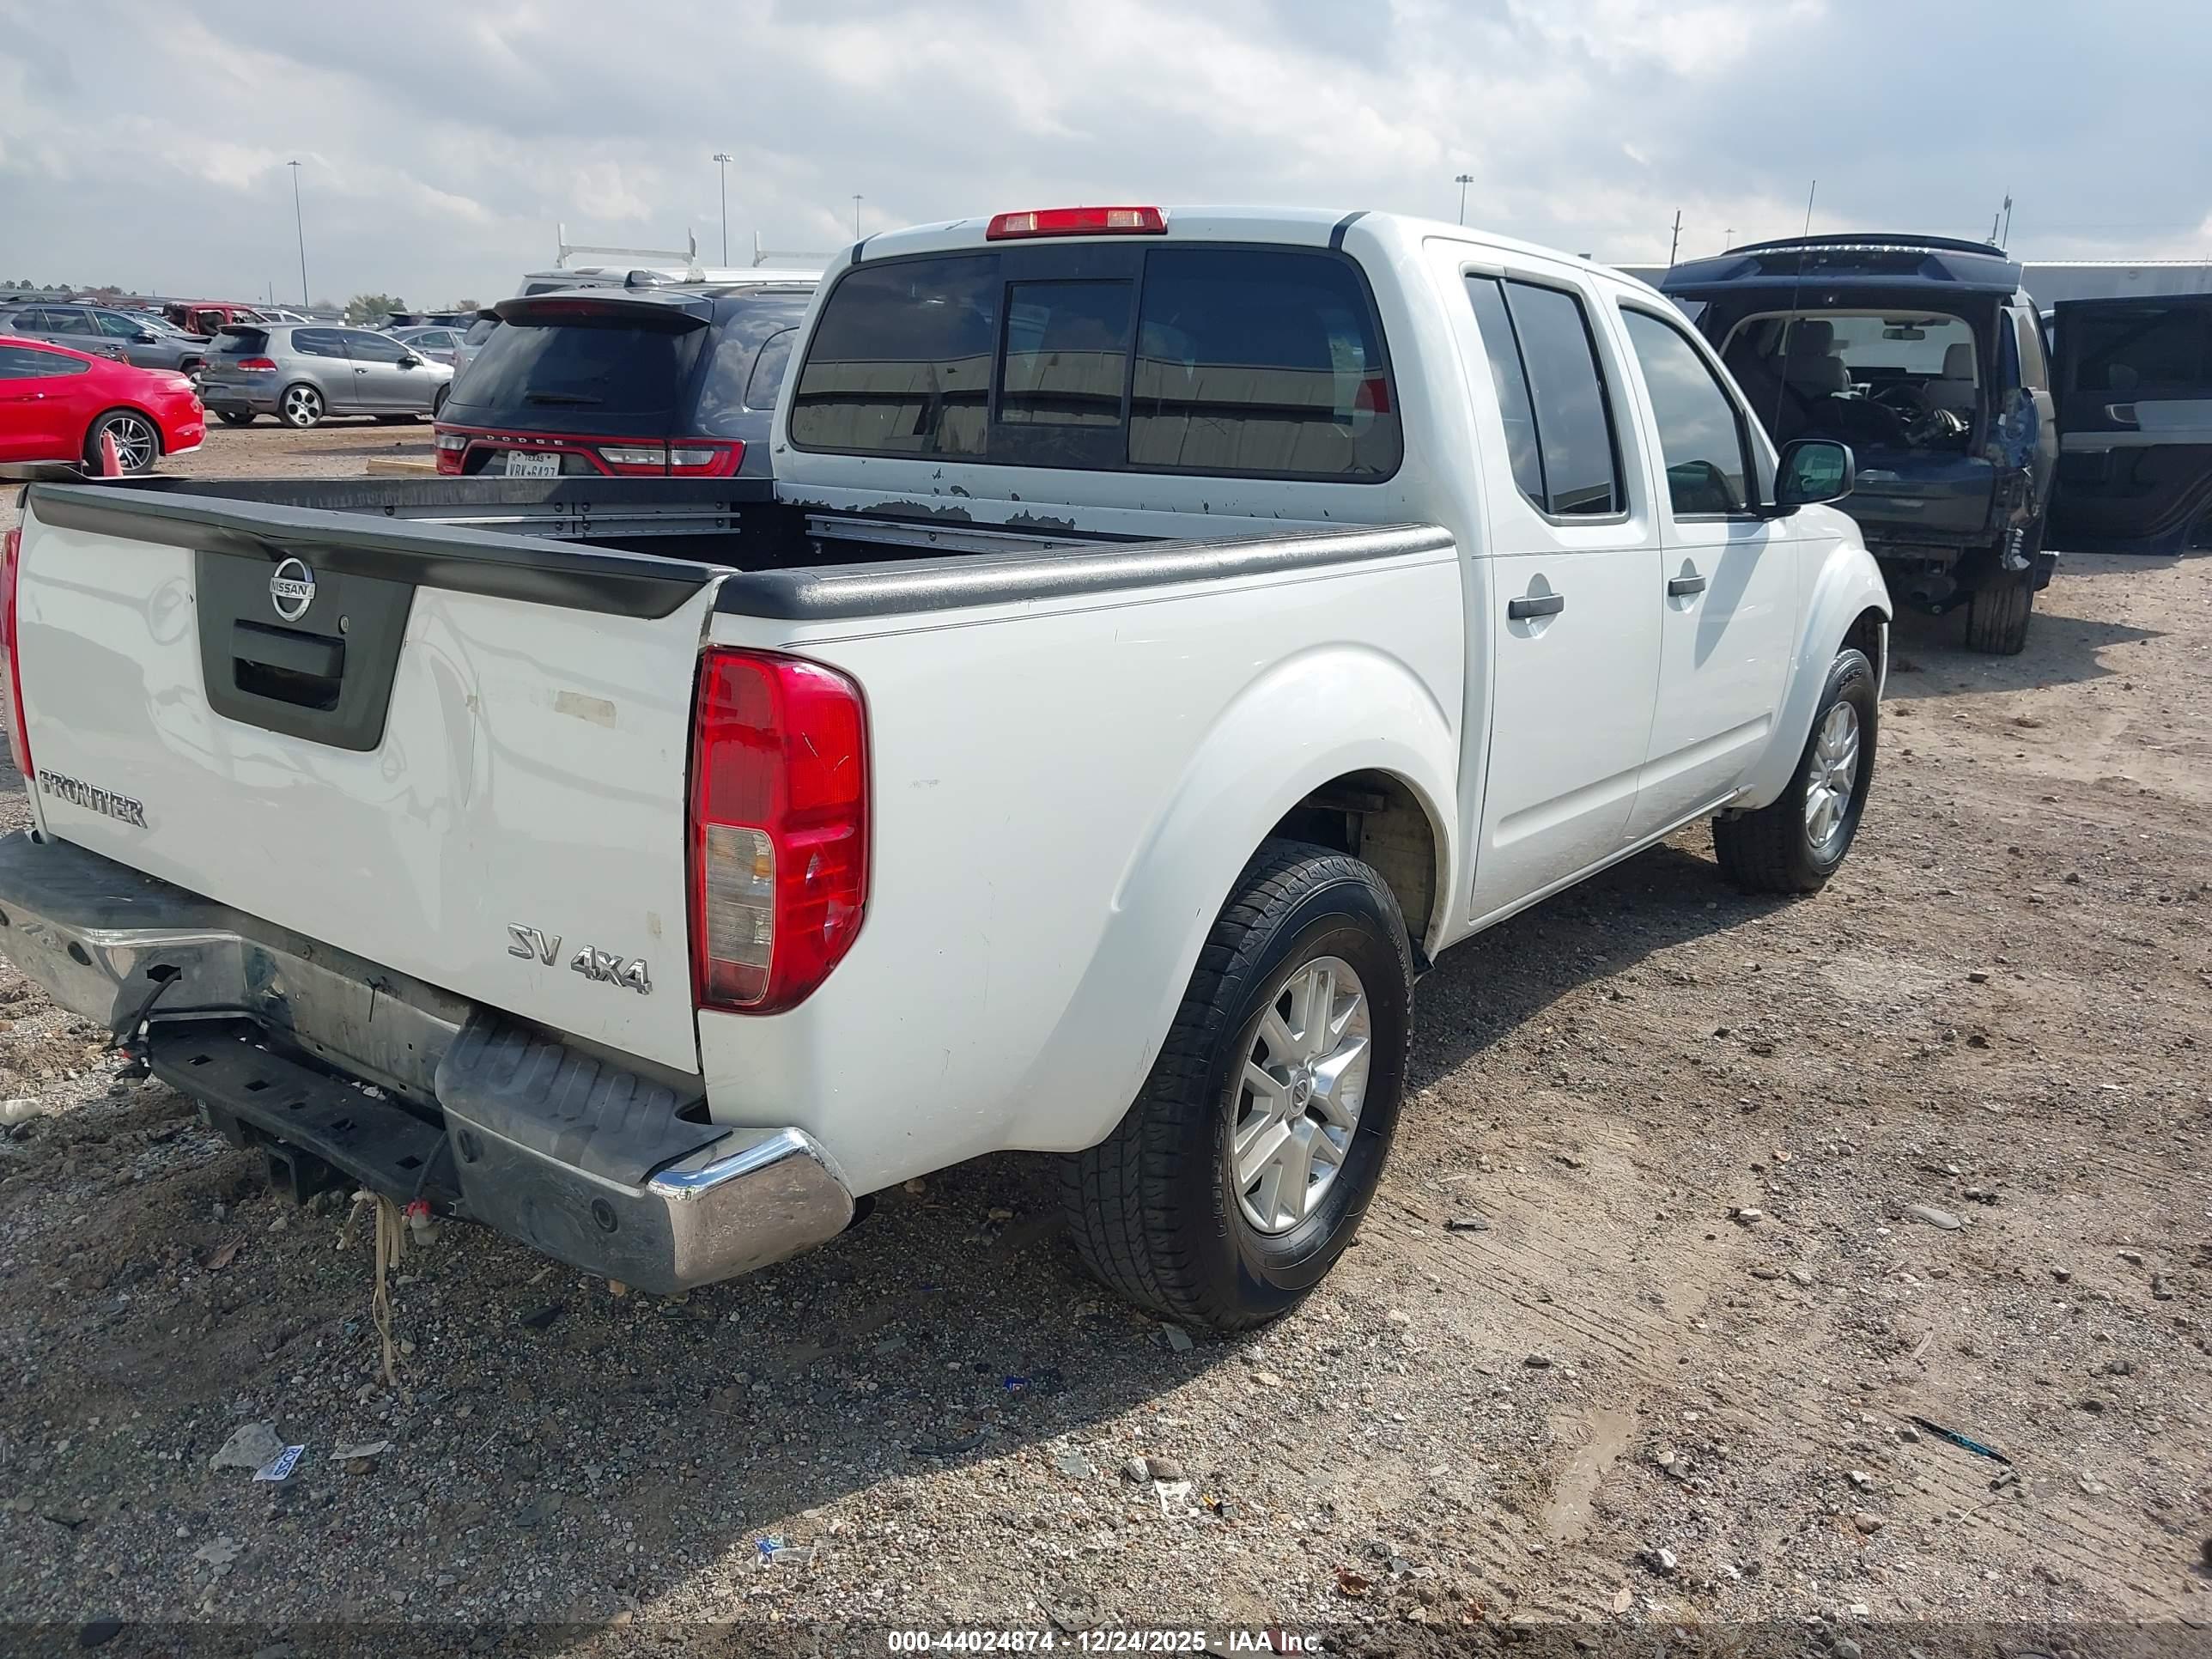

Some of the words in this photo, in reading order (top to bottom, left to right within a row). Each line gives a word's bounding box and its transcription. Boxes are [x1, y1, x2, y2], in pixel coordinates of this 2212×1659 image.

[486, 434, 564, 446] DODGE
[524, 453, 544, 463] TEXAS
[271, 580, 307, 595] NISSAN
[40, 768, 148, 830] FRONTIER
[507, 922, 562, 967] SV
[274, 1448, 302, 1476] ROSS
